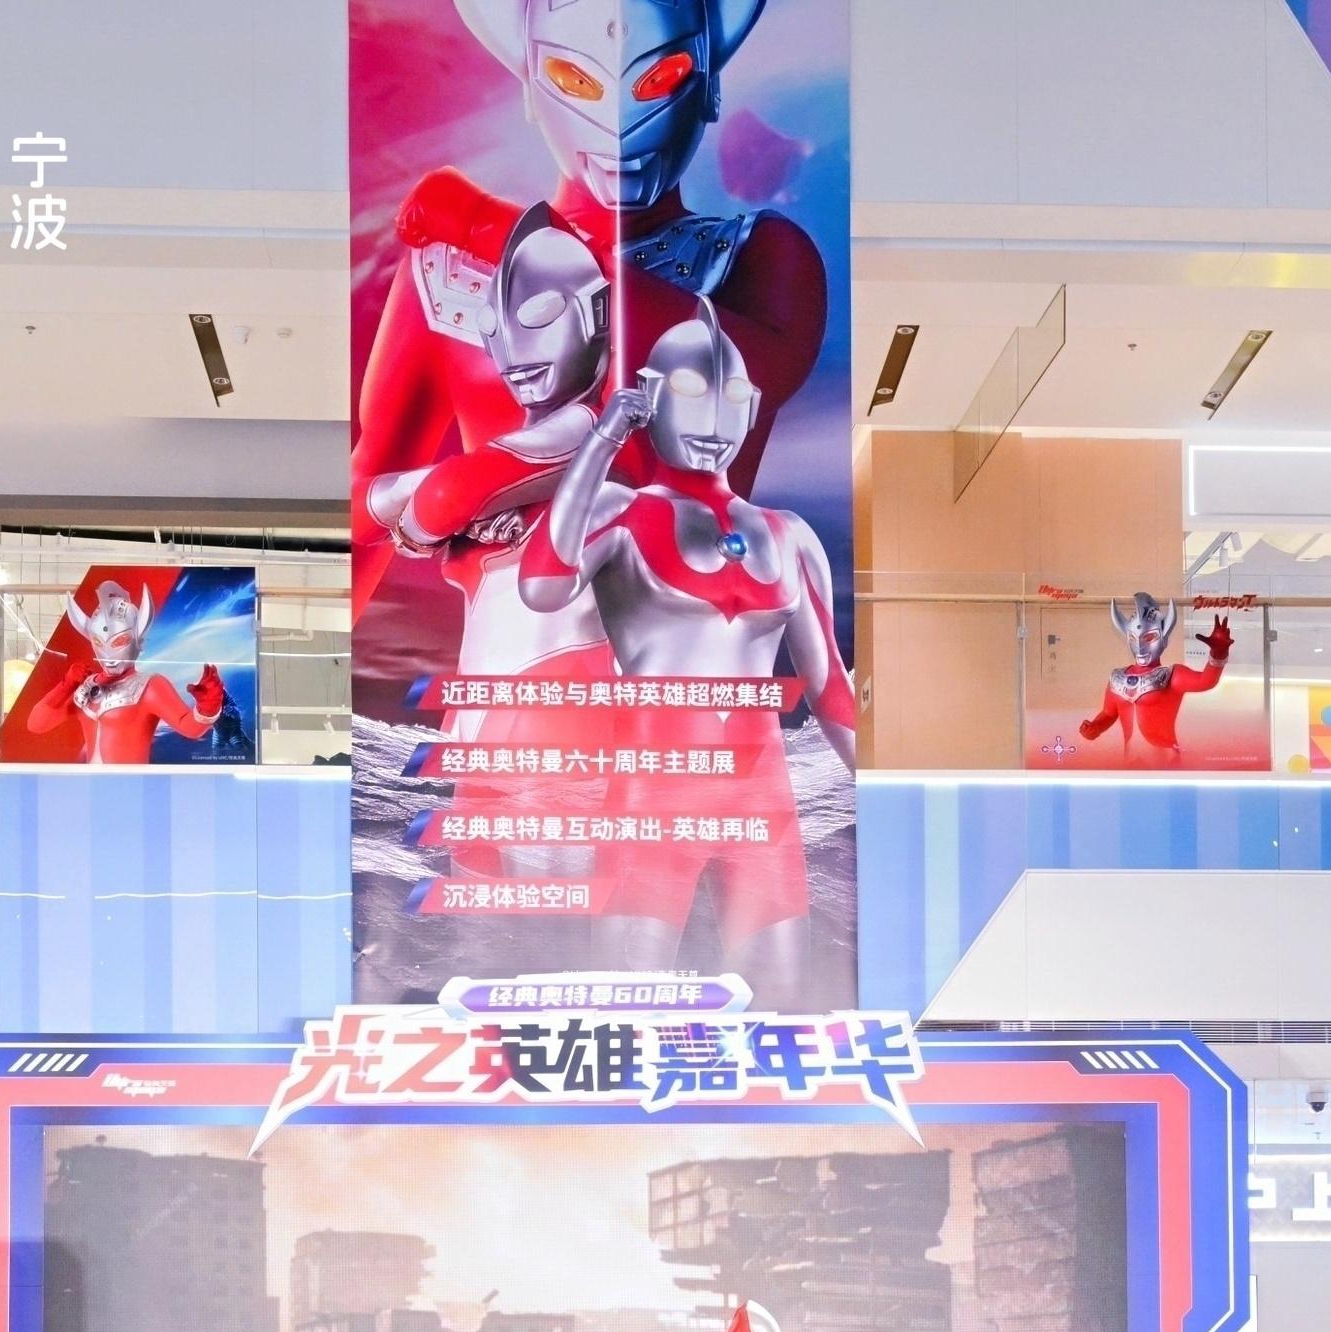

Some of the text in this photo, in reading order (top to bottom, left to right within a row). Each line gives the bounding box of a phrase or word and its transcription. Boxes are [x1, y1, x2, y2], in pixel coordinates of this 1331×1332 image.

[441, 680, 784, 709] 近距离体验与奥特英雄超燃集结
[441, 748, 735, 776] 经典奥特曼六十周年主题展
[441, 816, 770, 843] 经典奥特曼互动演出-英雄再临
[442, 883, 590, 909] 沉浸体验空间
[488, 984, 703, 1007] 经典奥特曼60周年
[278, 1014, 918, 1106] 光之英雄嘉年华
